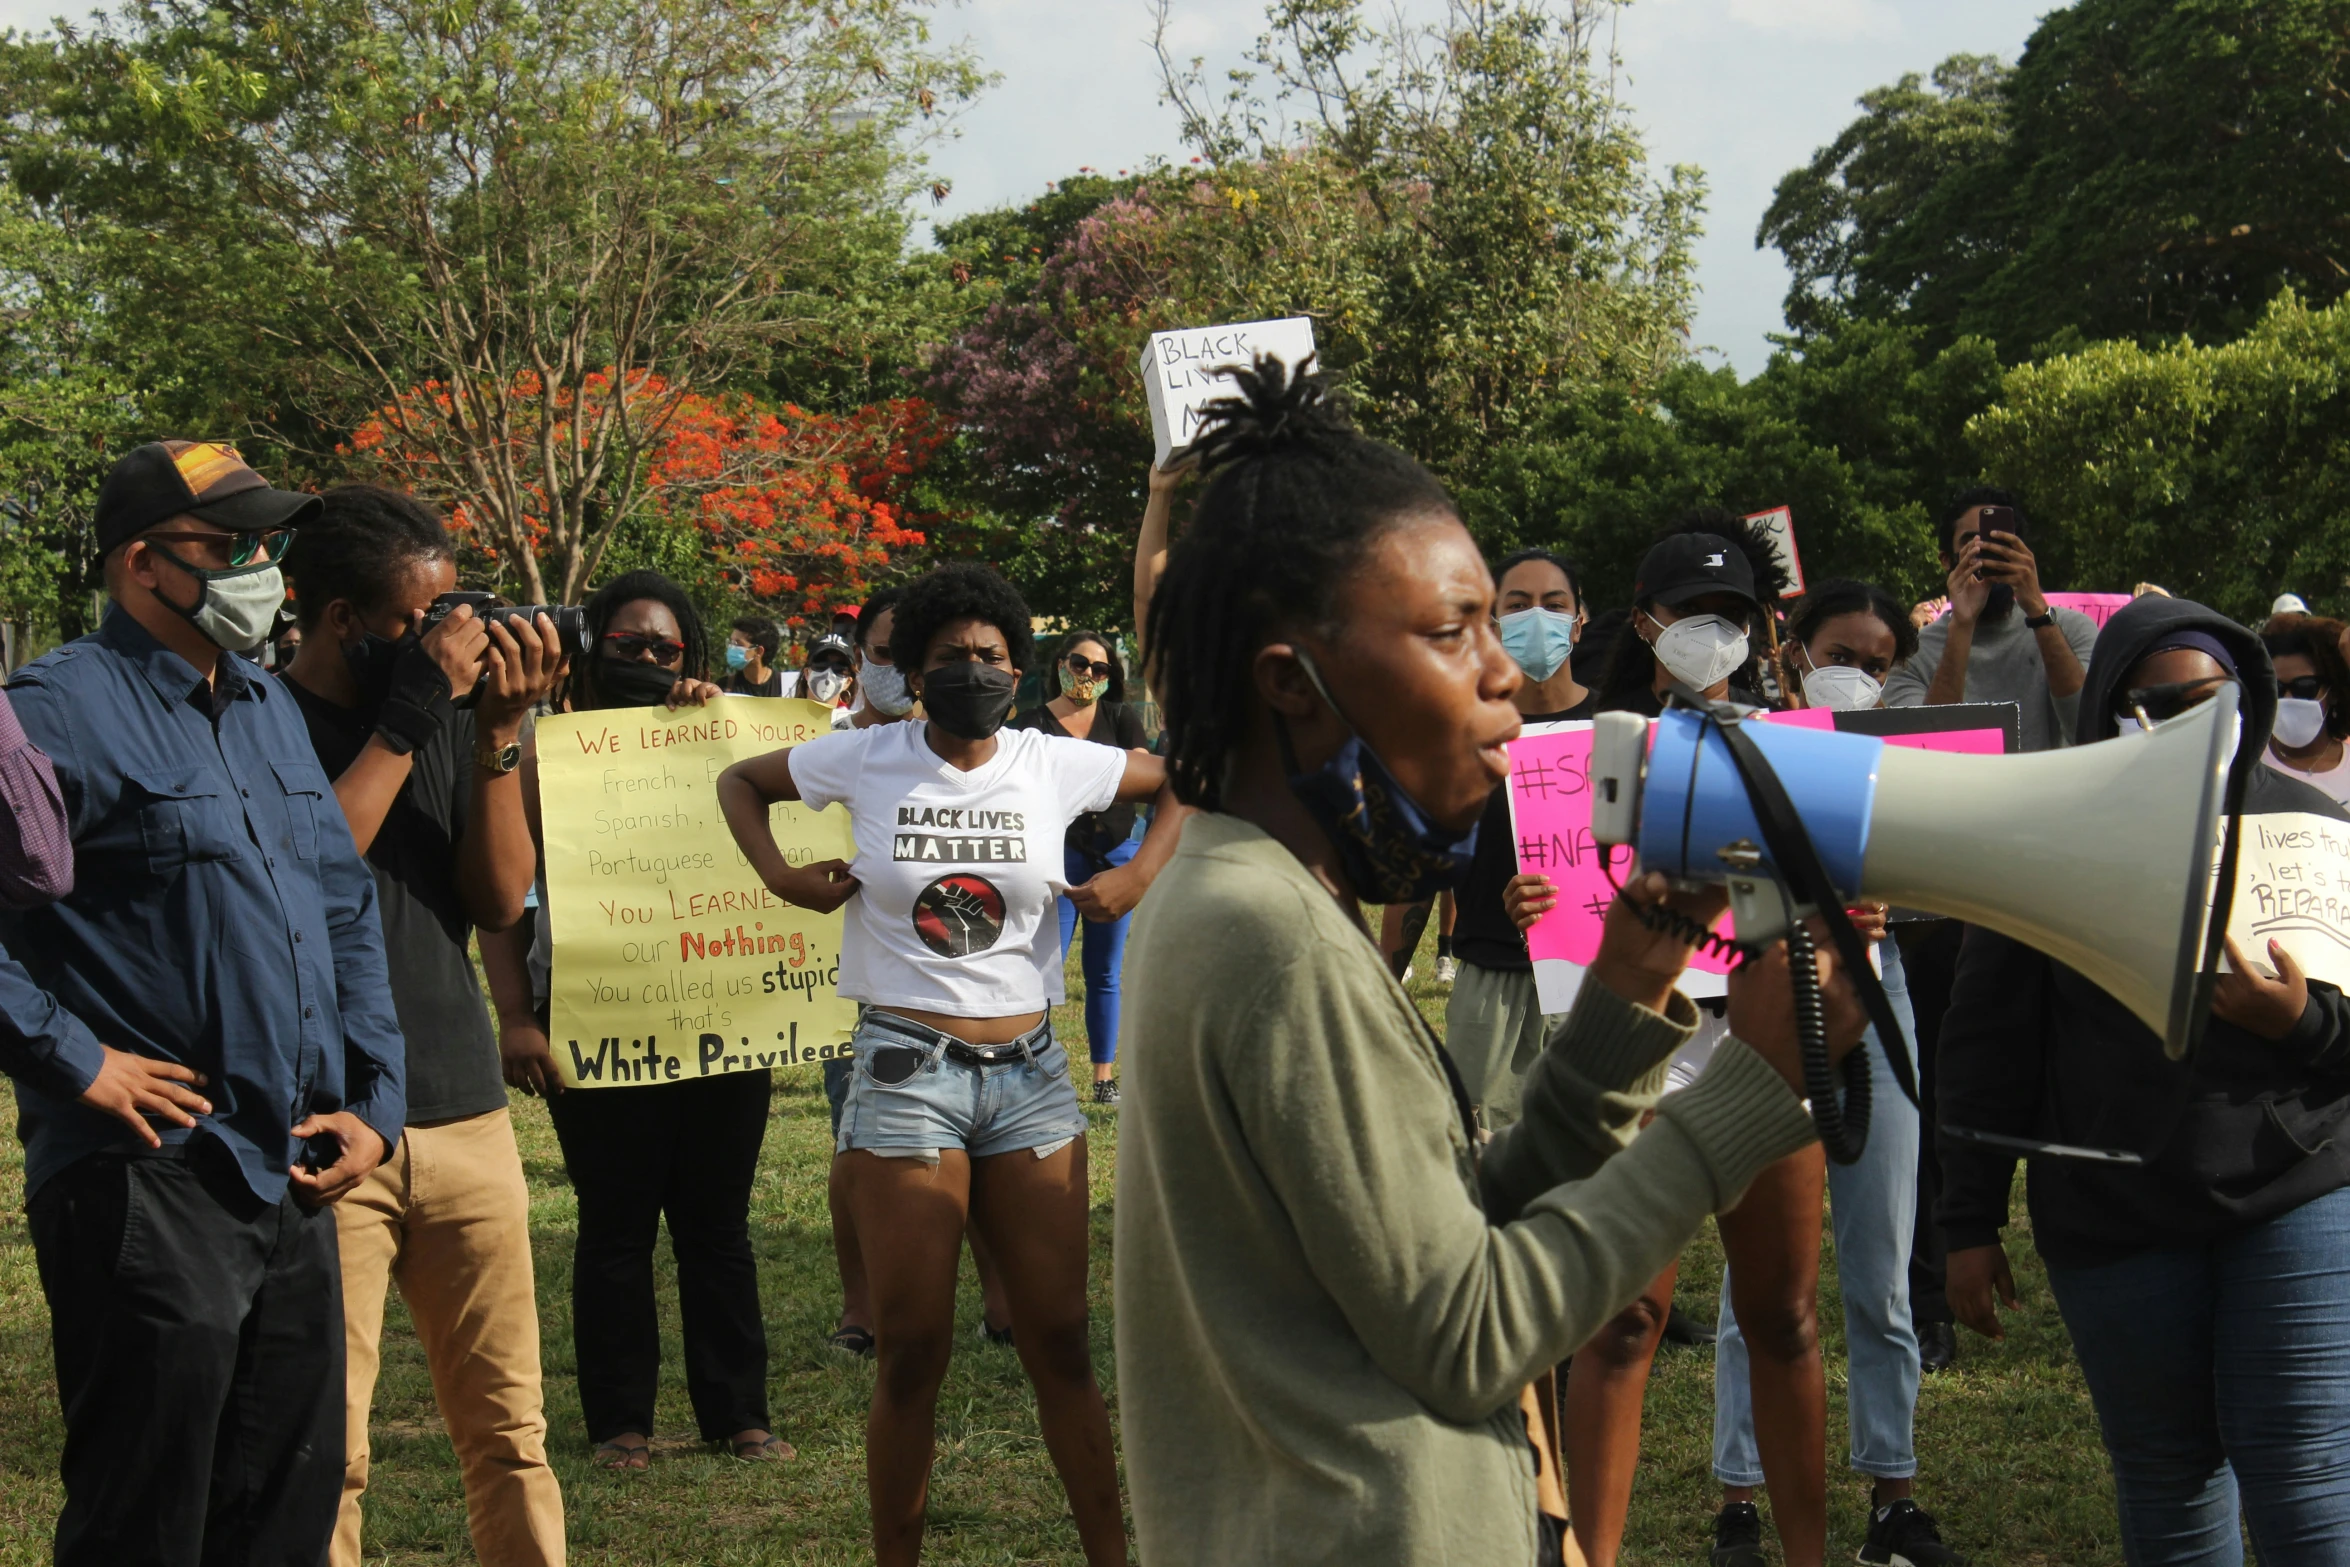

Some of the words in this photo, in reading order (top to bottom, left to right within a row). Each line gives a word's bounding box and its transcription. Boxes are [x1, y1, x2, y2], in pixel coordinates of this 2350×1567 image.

[1158, 332, 1251, 365] BLACK
[1167, 363, 1252, 389] LIVE
[576, 727, 621, 754] WE
[640, 719, 738, 749] LEARNED
[897, 807, 964, 830] BLACK
[968, 810, 1025, 831] LIVES
[894, 837, 1025, 860] MATTER
[2258, 823, 2315, 850] lives
[588, 848, 715, 885] Portuguese
[669, 888, 793, 920] LEARNE
[622, 939, 670, 963] our
[586, 976, 630, 1004] You
[642, 969, 714, 1003] called
[726, 975, 753, 997] us
[667, 1002, 733, 1031] that's
[568, 1035, 681, 1082] White
